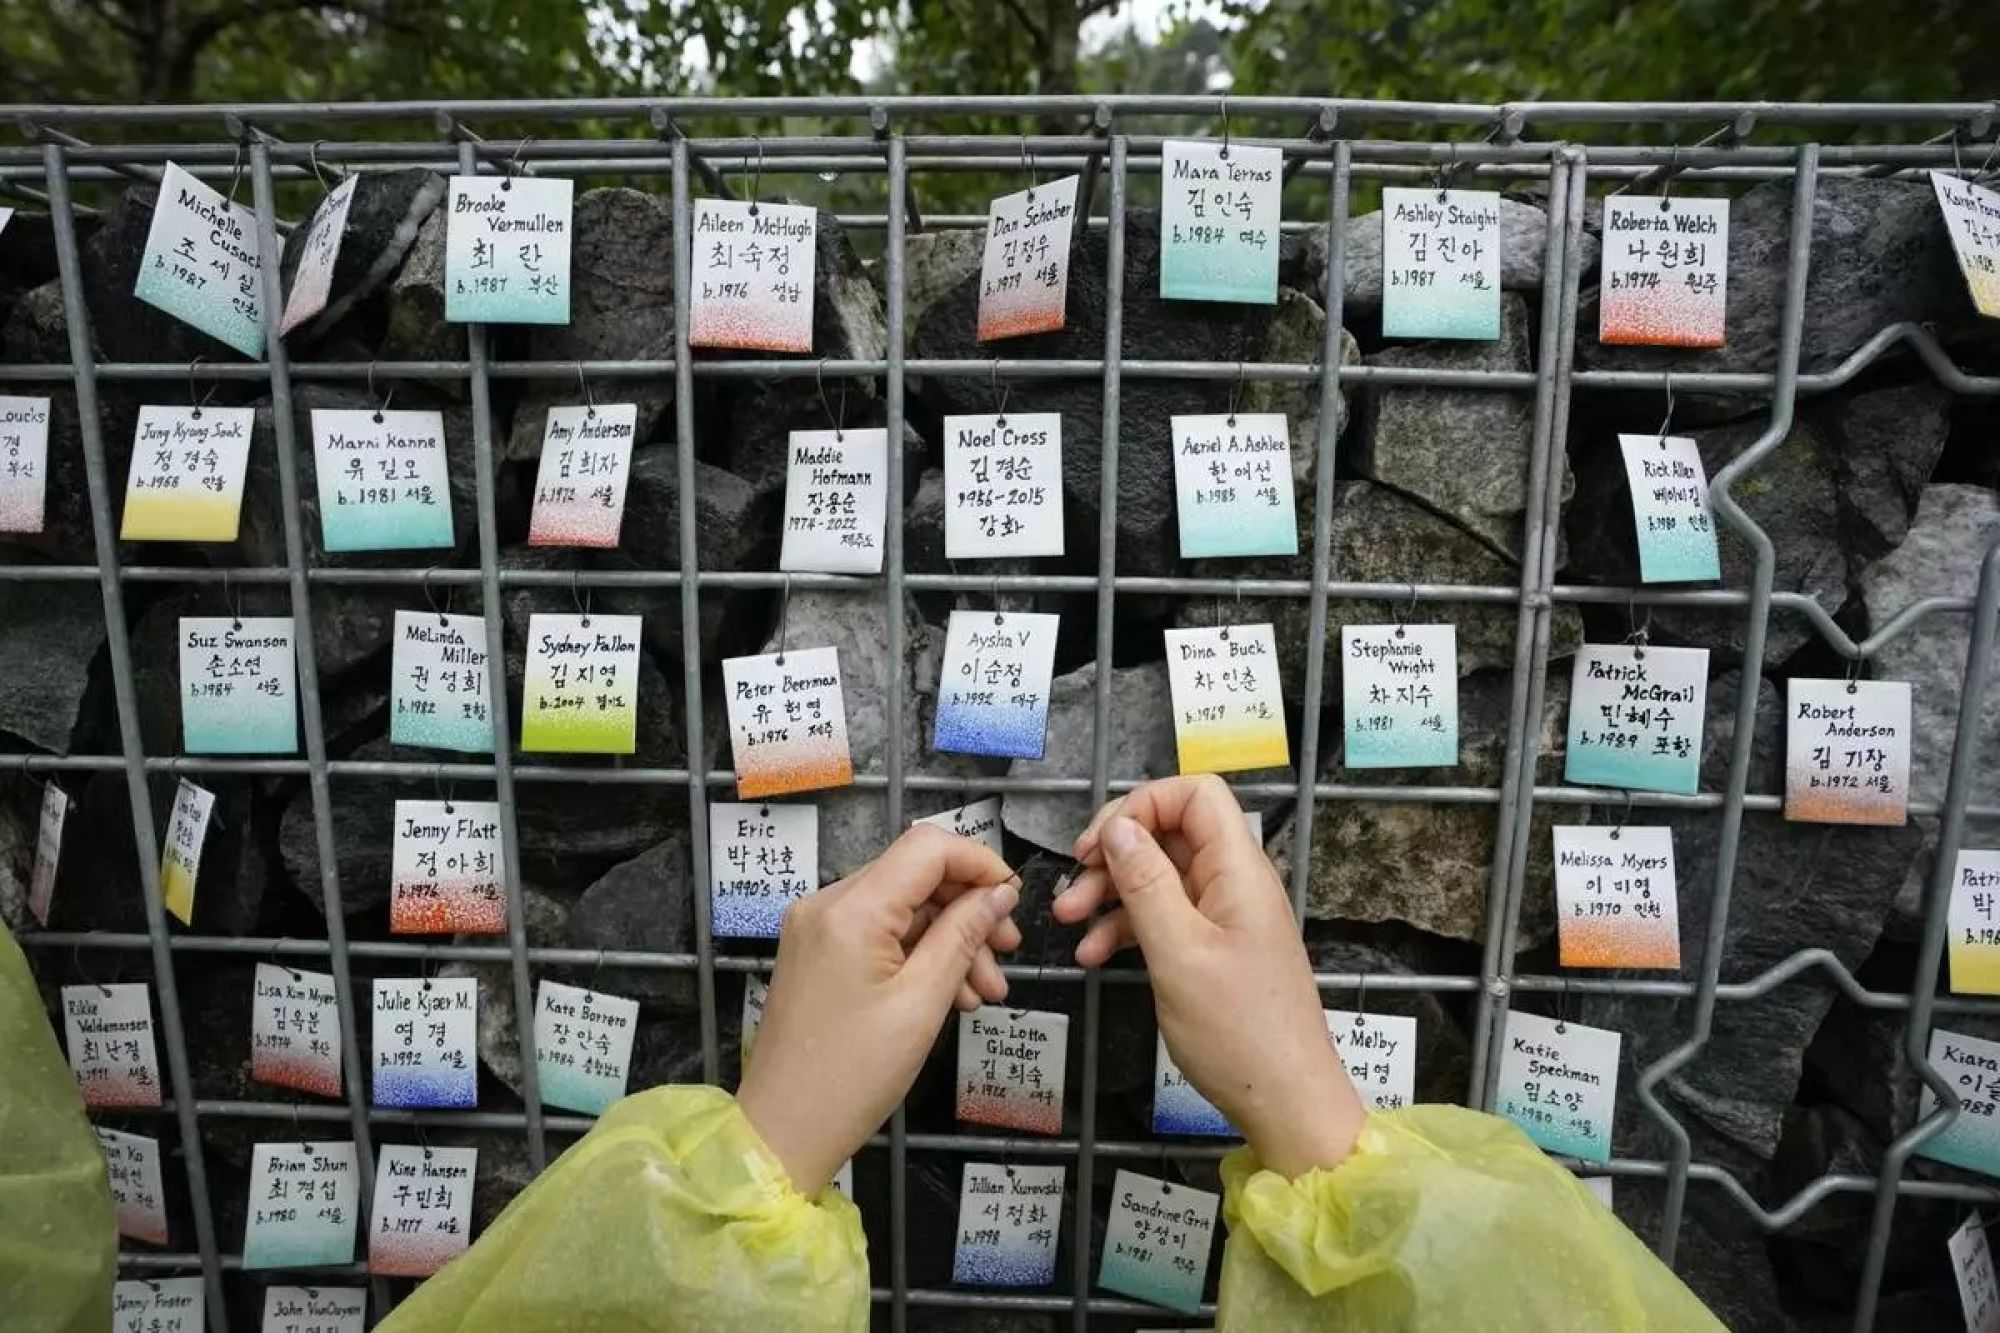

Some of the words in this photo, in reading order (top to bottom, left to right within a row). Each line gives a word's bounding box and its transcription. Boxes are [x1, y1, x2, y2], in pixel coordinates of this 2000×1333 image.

[1173, 160, 1219, 180] Mara
[1227, 163, 1271, 182] Terras
[455, 193, 505, 213] Brooke
[178, 184, 246, 243] Michelle
[487, 214, 563, 232] Vermullen
[1394, 203, 1443, 228] Ashley
[1448, 205, 1497, 231] Staight
[1610, 210, 1670, 231] Roberta
[1674, 215, 1716, 234] Welch
[698, 212, 743, 232] Aileen
[753, 217, 812, 242] McHugh
[993, 216, 1018, 237] Dan
[528, 275, 558, 295] 부산
[1035, 263, 1058, 287] 서울
[1460, 271, 1490, 290] 서울
[141, 423, 170, 445] Jung
[549, 421, 573, 442] Amy
[578, 420, 631, 438] Anderson
[959, 428, 995, 447] Noel
[1003, 429, 1047, 445] Cross
[328, 434, 378, 450] Marni
[387, 433, 435, 448] Kanne
[1182, 437, 1220, 455] Aeriel
[795, 447, 842, 465] Maddie
[813, 469, 870, 485] Hofmann
[1643, 460, 1670, 477] Rick
[405, 486, 435, 505] 서울
[590, 485, 614, 508] 서울
[1256, 487, 1280, 506] 서울
[980, 515, 1024, 537] 강화
[188, 632, 218, 648] Suz
[225, 632, 287, 648] Swanson
[538, 635, 590, 658] Sydney
[593, 635, 635, 652] Fallon
[969, 630, 1012, 653] Aysha
[1018, 631, 1030, 646] V
[1180, 645, 1215, 660] Dina
[1230, 640, 1265, 657] Buck
[442, 646, 488, 668] Miller
[1352, 638, 1422, 663] Stephanie
[1388, 659, 1434, 678] Wright
[1588, 660, 1645, 681] Patrick
[257, 678, 283, 696] 서울
[737, 681, 775, 700] Peter
[783, 675, 837, 697] Beerman
[1622, 685, 1693, 702] McGrail
[1011, 693, 1039, 710] 대구
[1245, 702, 1271, 719] 서울
[1798, 703, 1854, 719] Robert
[1422, 715, 1445, 733] 서울
[1825, 722, 1895, 737] Anderson
[1653, 736, 1691, 758] 포항
[1865, 775, 1892, 793] 서울
[402, 819, 450, 843] Jenny
[457, 820, 497, 839] Flatt
[738, 820, 774, 838] Eric
[1561, 852, 1613, 867] Melissa
[1622, 853, 1667, 871] Myers
[1635, 901, 1660, 918] 인천
[258, 980, 282, 998] Lisa
[377, 991, 410, 1010] Julie
[456, 991, 474, 1011] M.
[547, 997, 575, 1017] Kate
[581, 1006, 626, 1027] Borrero
[987, 1040, 1040, 1060] Glader
[1350, 1030, 1397, 1056] Melby
[1513, 1038, 1558, 1060] Katie
[440, 1050, 466, 1068] 서울
[1944, 1046, 1997, 1071] Kiara
[1528, 1060, 1598, 1085] Speckman
[268, 1157, 305, 1173] Brian
[389, 1160, 415, 1176] Kine
[423, 1163, 467, 1178] Hansen
[1121, 1193, 1180, 1223] Sandrine
[438, 1218, 460, 1233] 서울
[274, 1301, 303, 1316] John
